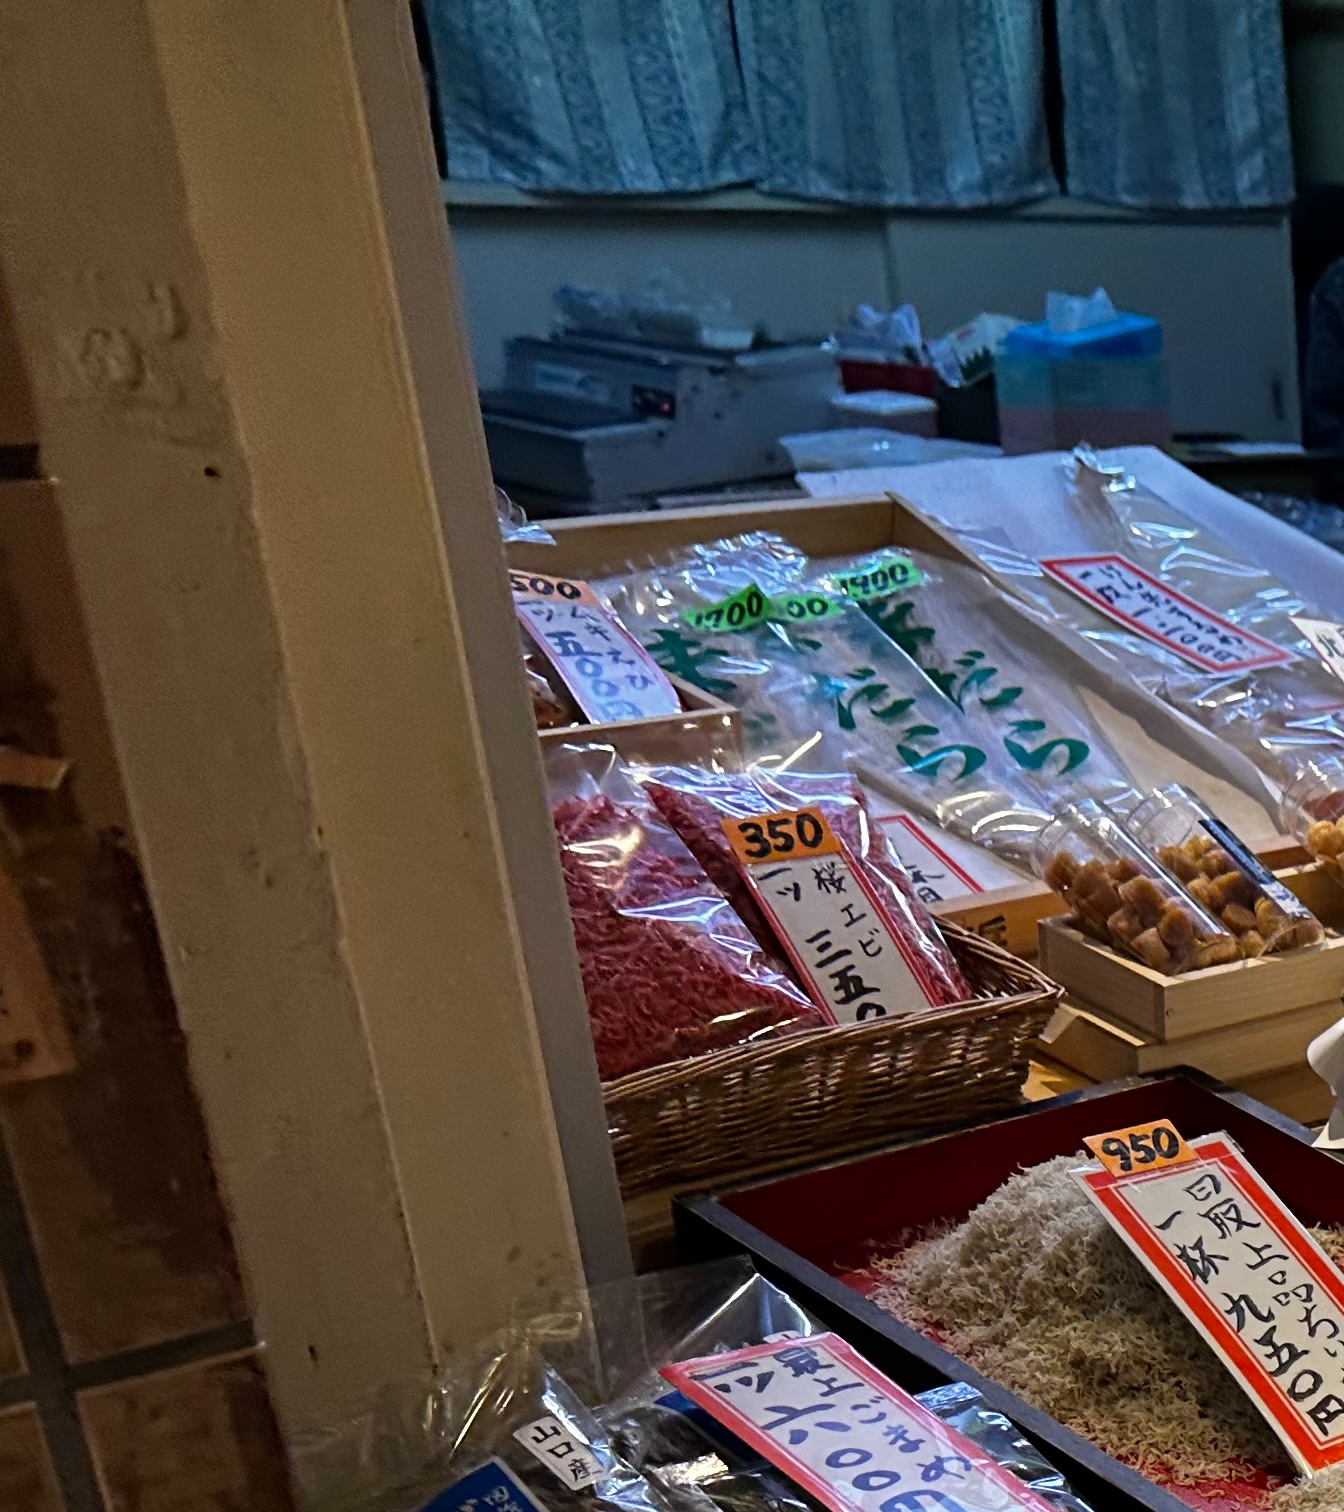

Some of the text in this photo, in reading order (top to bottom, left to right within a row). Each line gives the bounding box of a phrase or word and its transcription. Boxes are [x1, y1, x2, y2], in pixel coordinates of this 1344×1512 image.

[737, 815, 825, 859] 350
[815, 867, 883, 957] 桜エビ
[1100, 1126, 1179, 1170] 950
